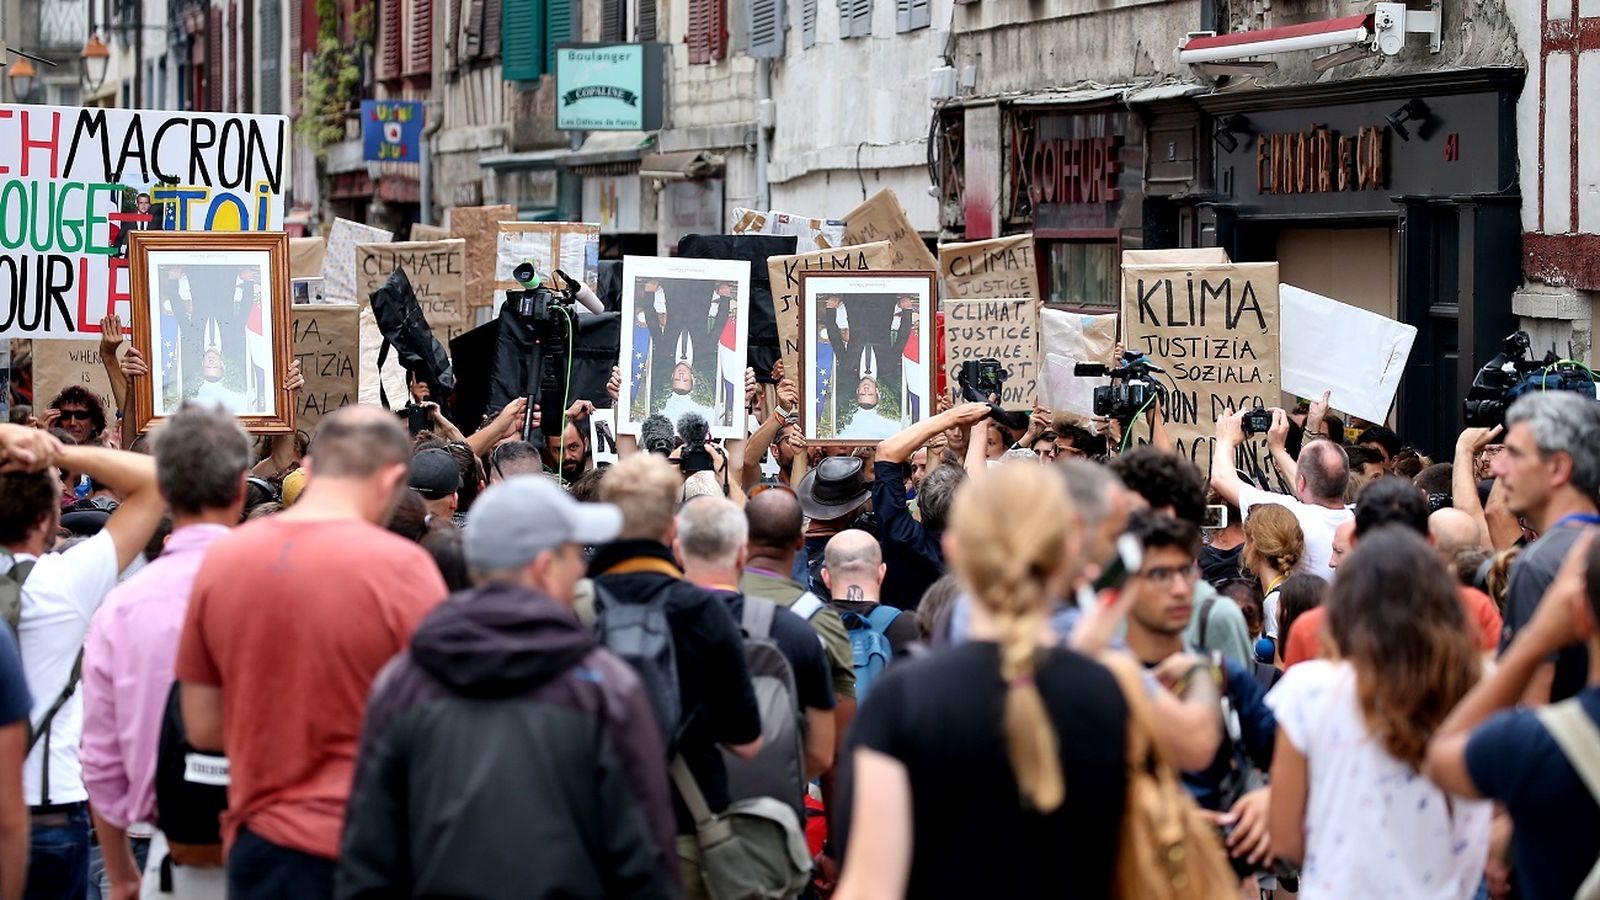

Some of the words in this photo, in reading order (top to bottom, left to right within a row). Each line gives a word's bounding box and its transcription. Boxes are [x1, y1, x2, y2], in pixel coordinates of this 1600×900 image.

[568, 51, 632, 64] Boulanger
[63, 109, 284, 195] MACRON
[1032, 136, 1118, 204] COIFFURE
[363, 251, 462, 278] CLIMATE,
[0, 254, 75, 332] OUR
[958, 276, 1030, 296] JUSTICE
[952, 300, 1026, 325] CLIMAT,
[948, 326, 1031, 342] JUSTICE
[69, 349, 102, 365] WHER
[294, 350, 354, 378] TIZIA
[951, 379, 1037, 405] MON?
